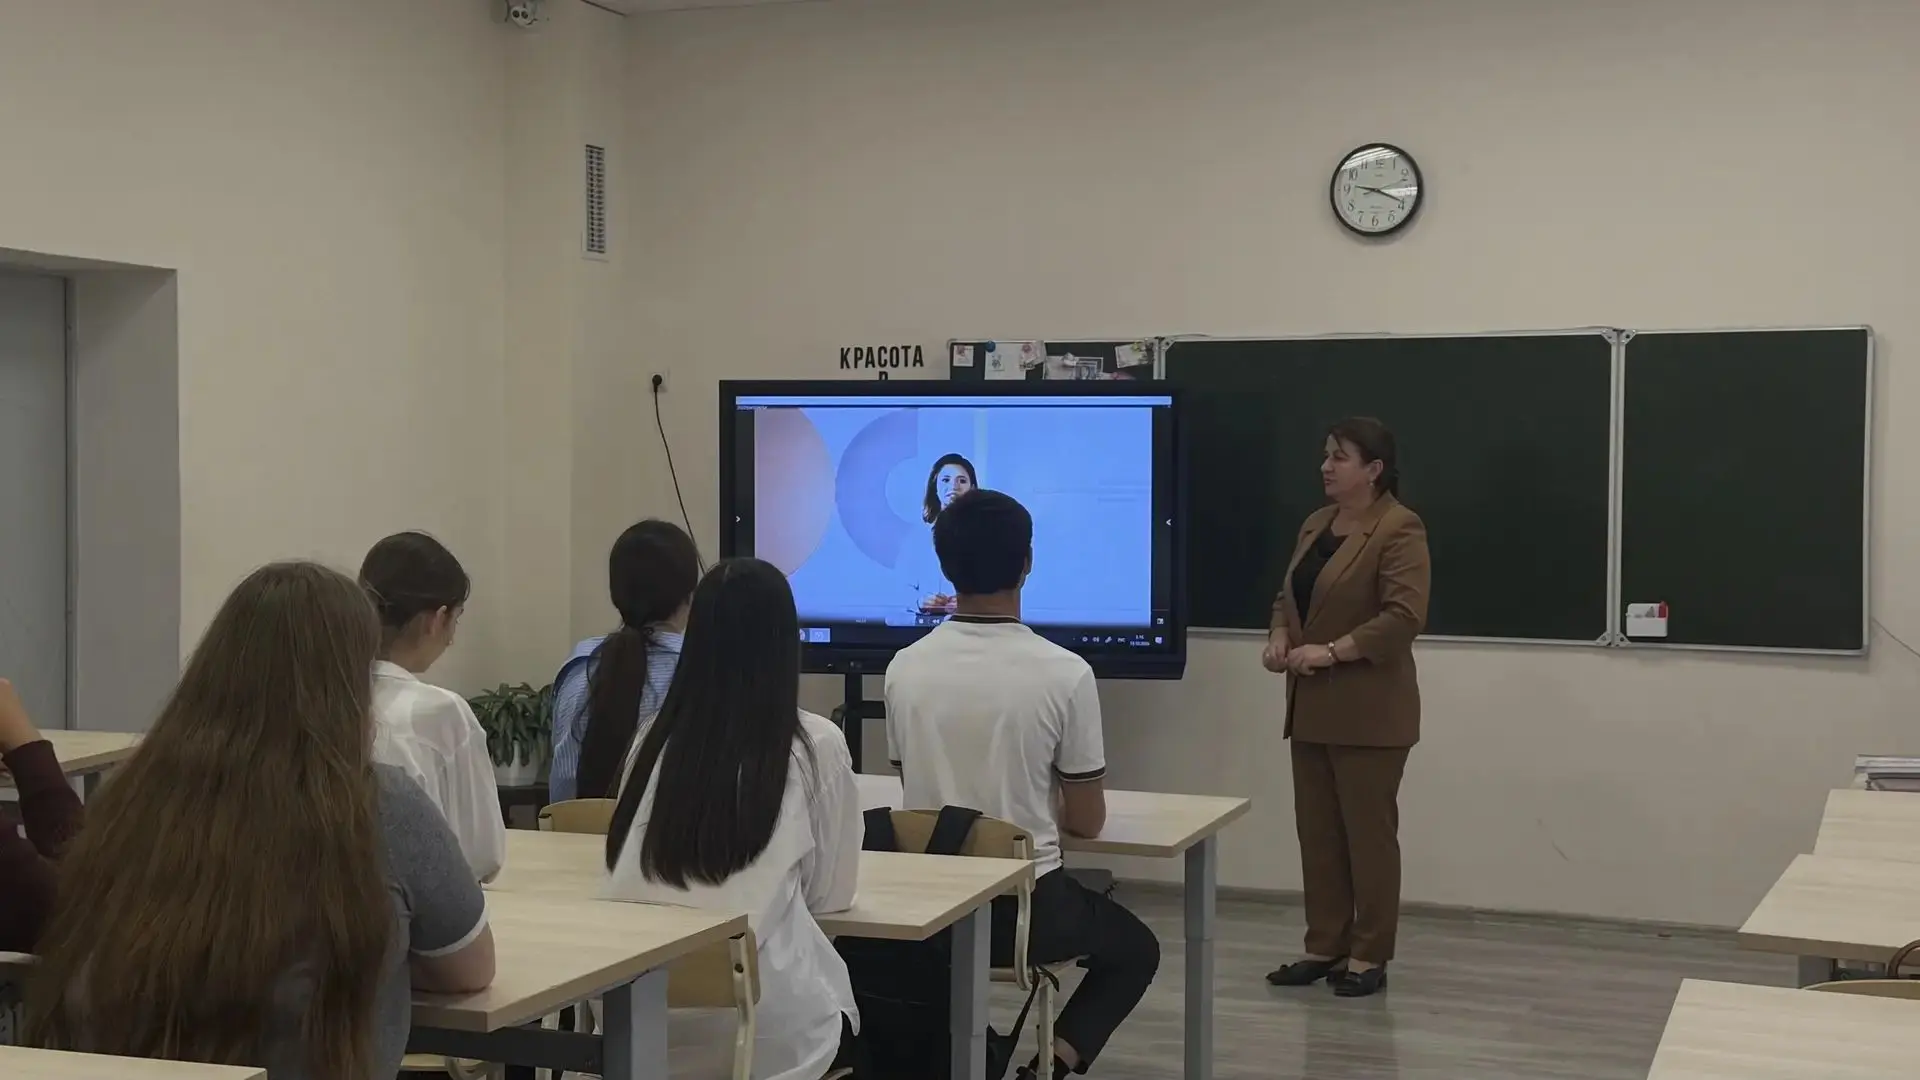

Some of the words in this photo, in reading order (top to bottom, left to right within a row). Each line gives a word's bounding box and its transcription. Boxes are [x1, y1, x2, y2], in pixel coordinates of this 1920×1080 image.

[1348, 168, 1358, 181] 10
[1343, 183, 1351, 195] 9
[1347, 199, 1356, 212] 8
[1398, 198, 1405, 211] 4
[1358, 210, 1364, 223] 7
[1372, 214, 1379, 226] 6
[1387, 210, 1396, 222] 5
[840, 345, 924, 369] КРАСОТА
